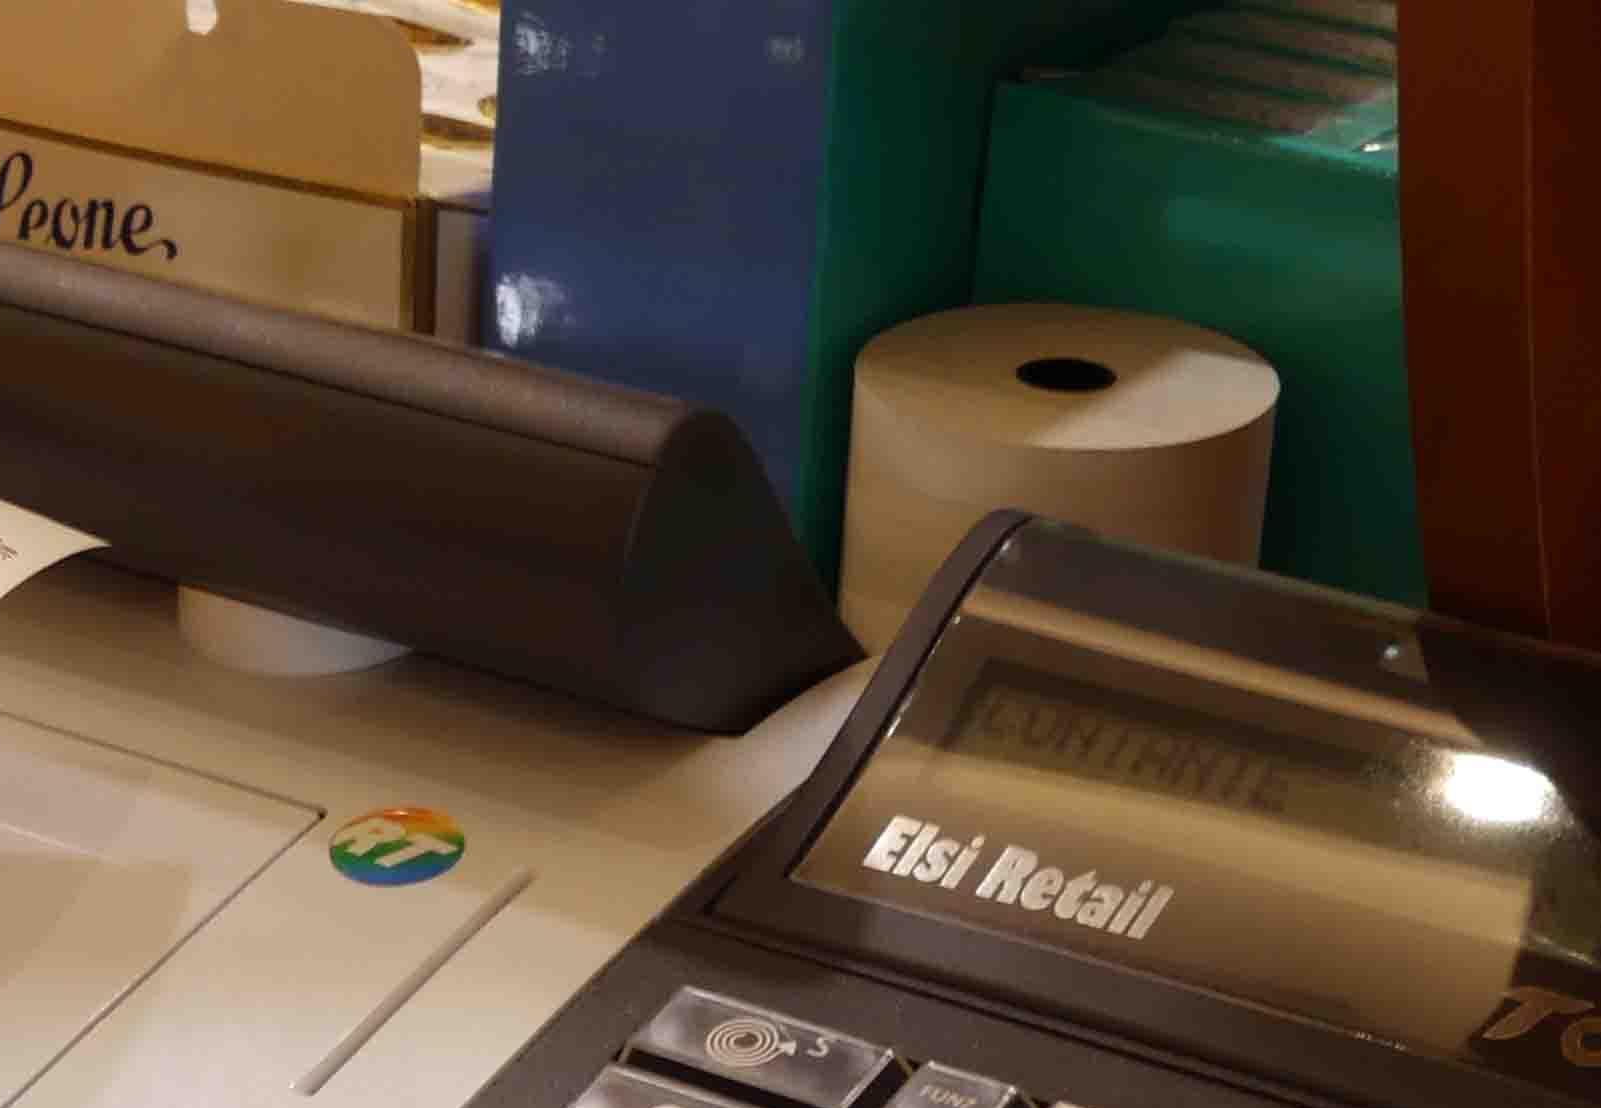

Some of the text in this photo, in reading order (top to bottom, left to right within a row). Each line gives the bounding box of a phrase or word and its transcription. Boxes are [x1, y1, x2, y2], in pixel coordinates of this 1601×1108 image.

[862, 814, 1174, 941] Elsi Retail
[807, 1037, 830, 1058] S
